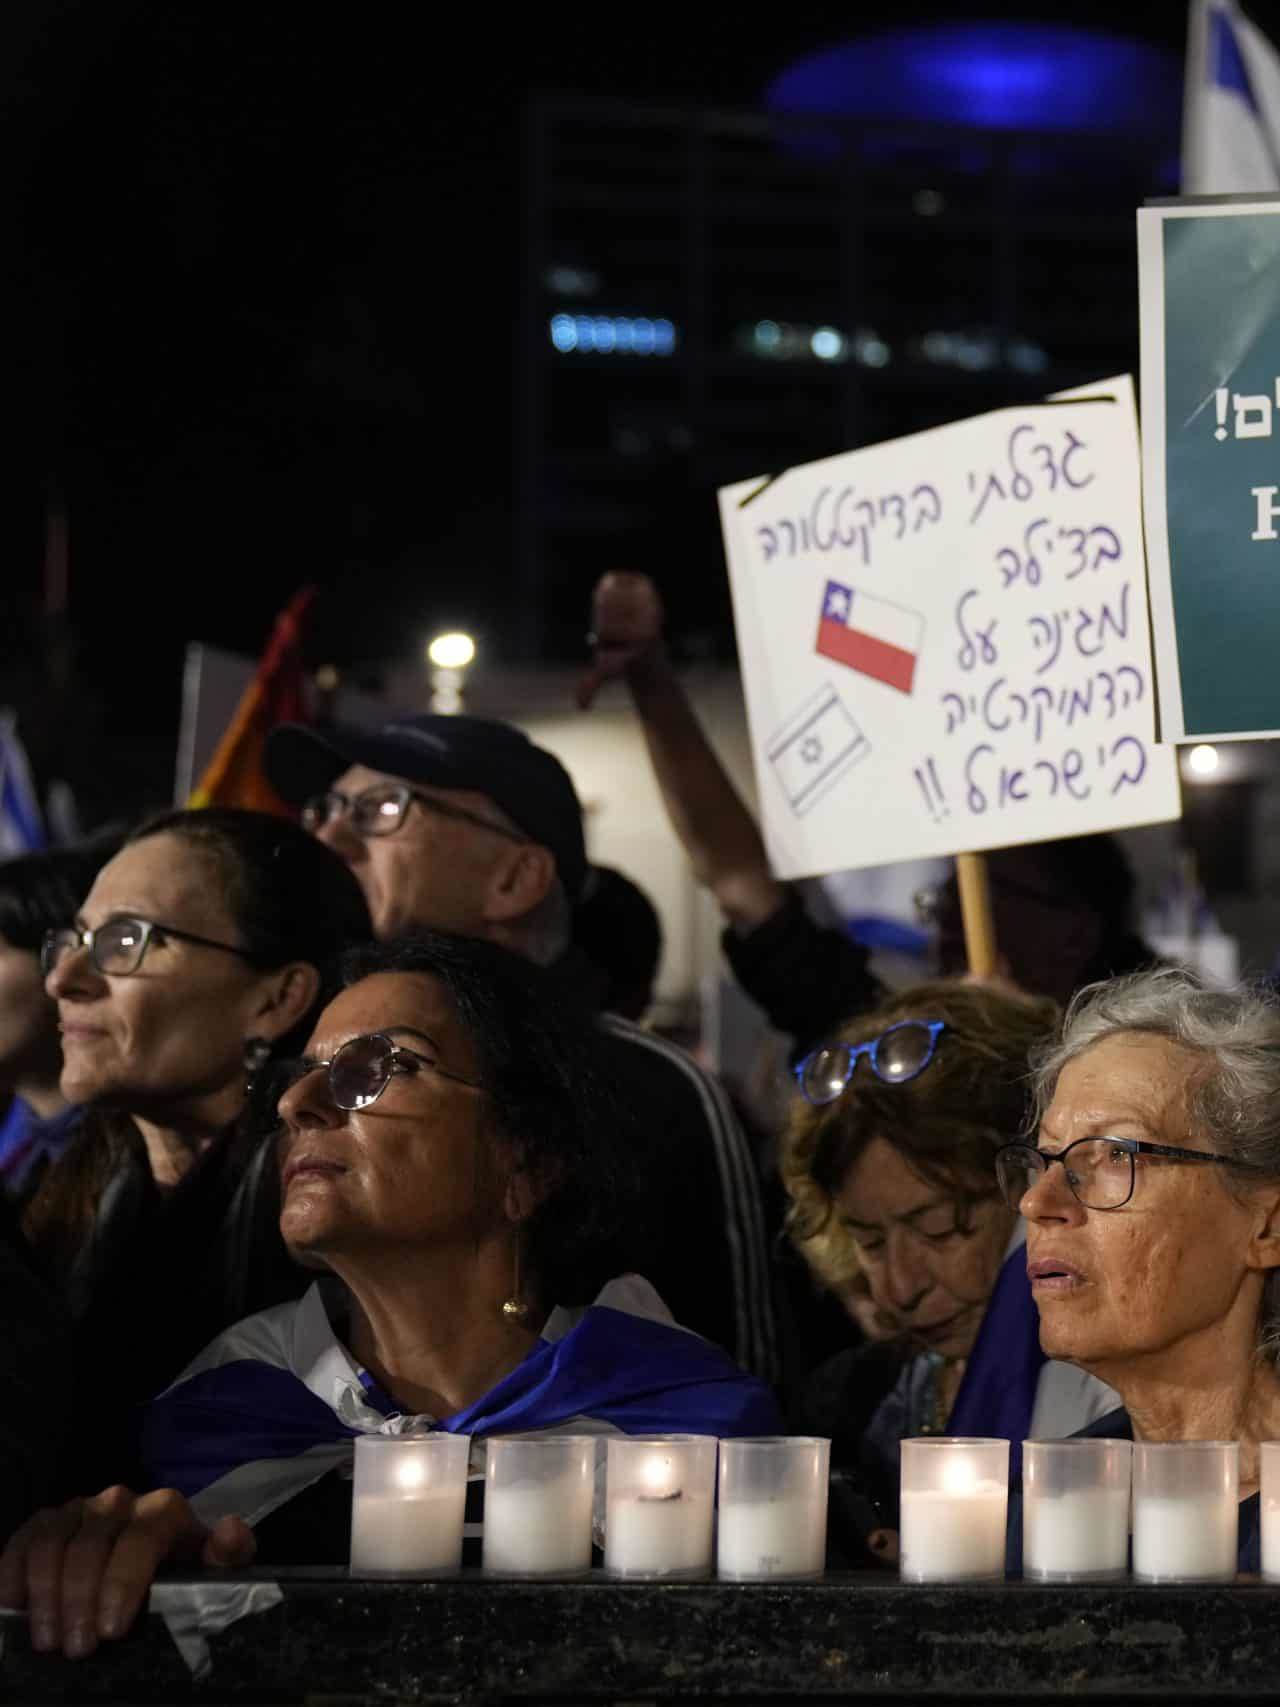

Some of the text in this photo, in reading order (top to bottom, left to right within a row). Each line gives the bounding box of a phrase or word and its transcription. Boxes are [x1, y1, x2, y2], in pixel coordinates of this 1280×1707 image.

[967, 424, 1096, 524] גדלתי
[955, 582, 1130, 675] מגינה על
[940, 665, 1144, 743] הדמוקרטיה
